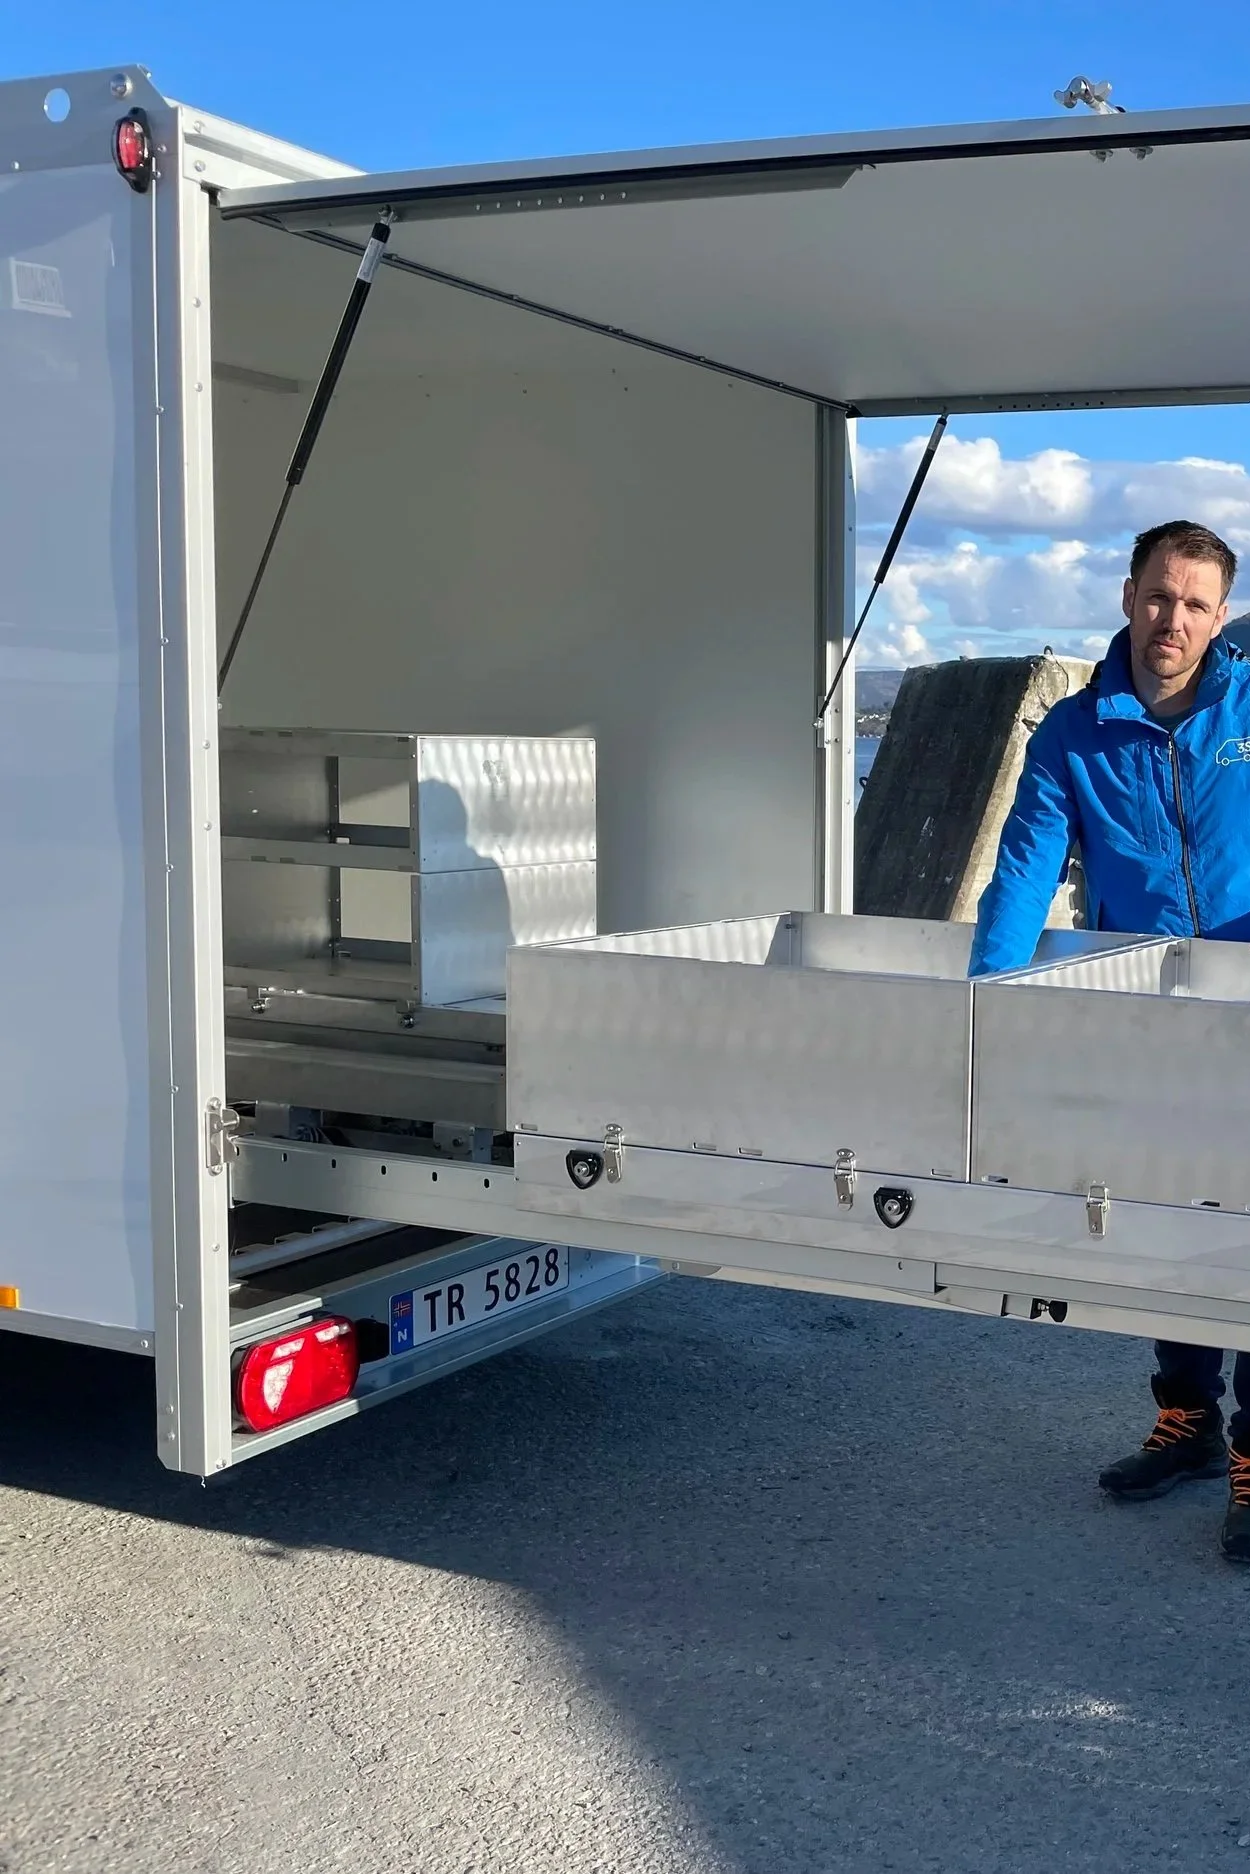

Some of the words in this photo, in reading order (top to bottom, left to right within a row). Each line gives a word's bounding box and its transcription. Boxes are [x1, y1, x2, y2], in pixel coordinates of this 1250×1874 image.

[423, 1283, 466, 1332] TR
[484, 1248, 559, 1311] 5828
[397, 1327, 408, 1342] N
